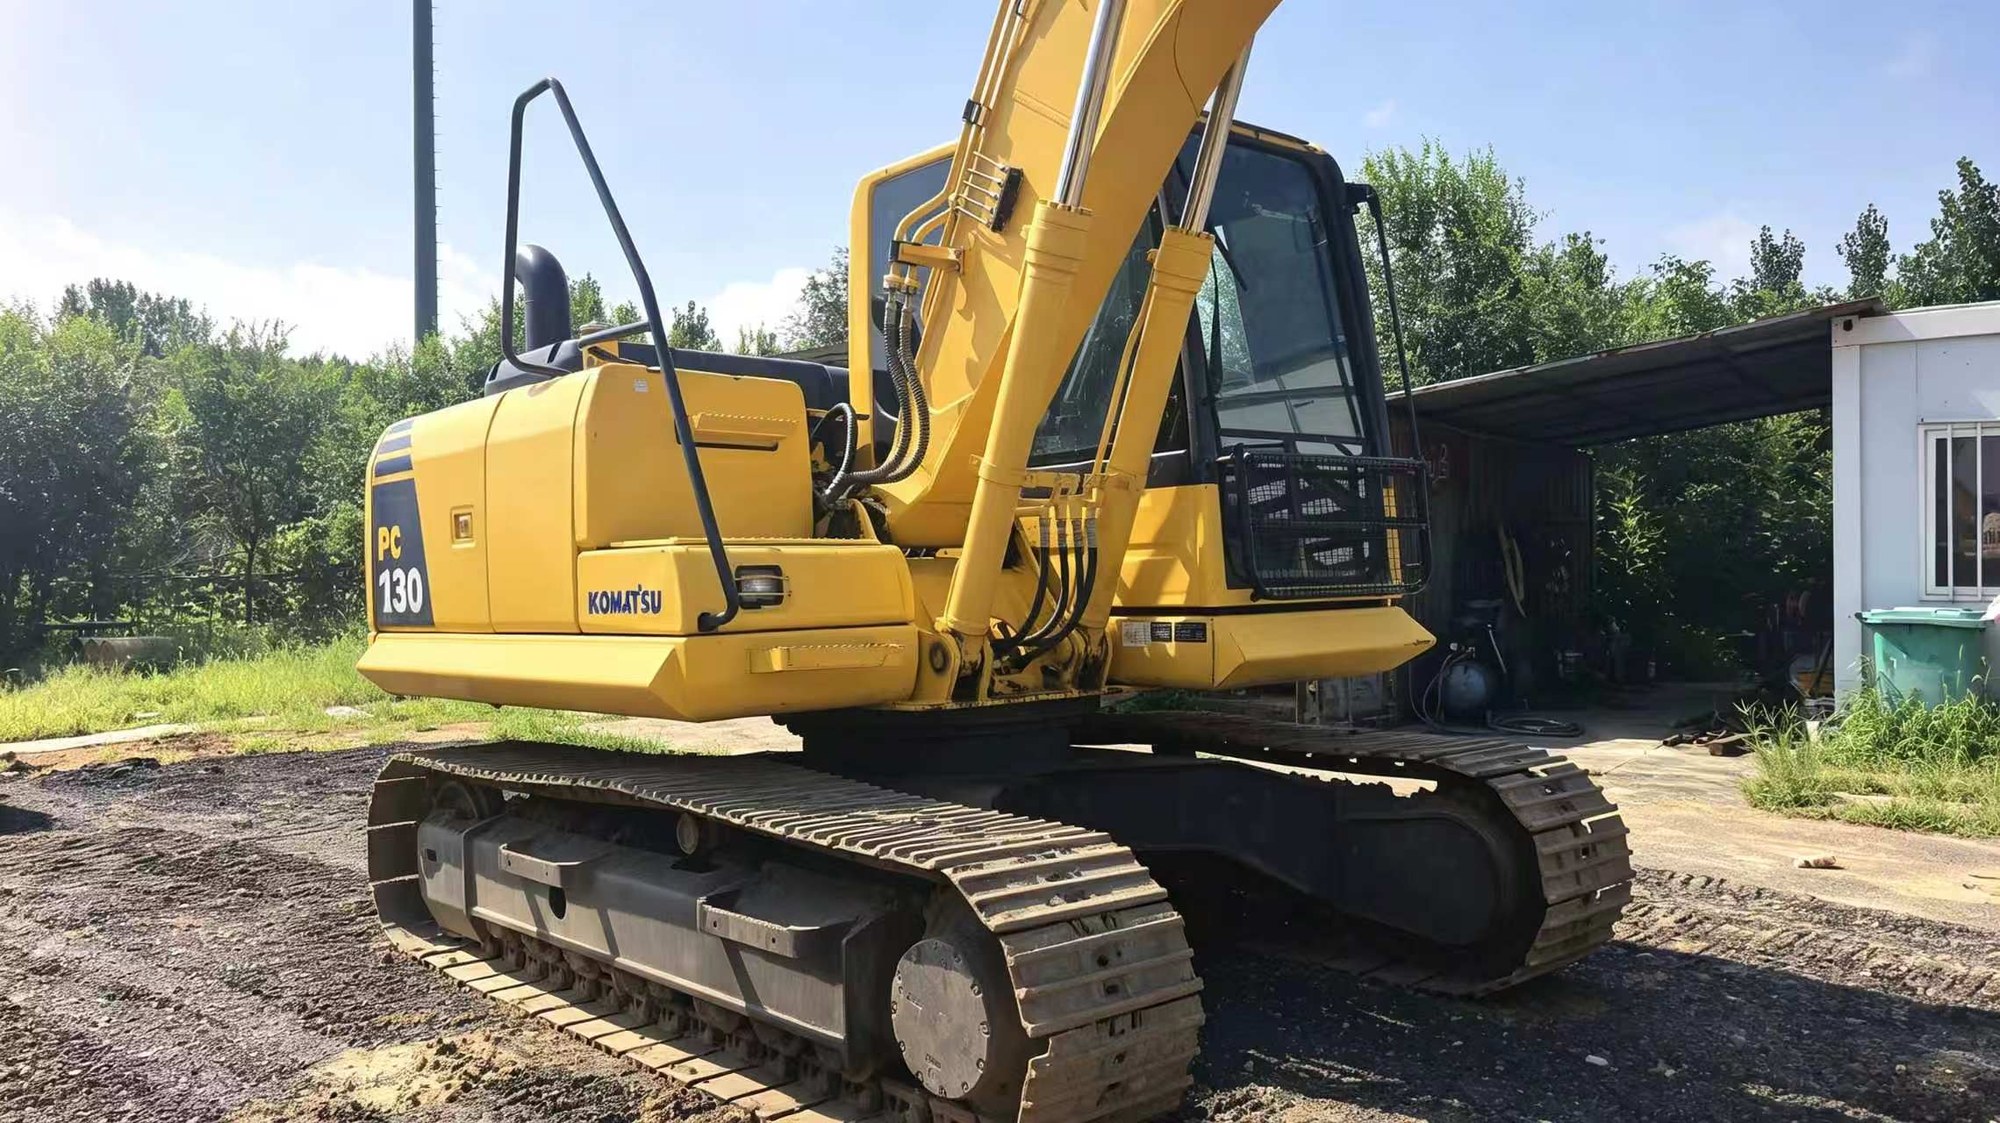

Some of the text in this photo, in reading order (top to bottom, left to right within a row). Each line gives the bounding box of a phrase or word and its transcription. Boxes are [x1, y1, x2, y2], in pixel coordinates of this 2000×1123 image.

[378, 525, 401, 561] PC
[378, 567, 423, 614] 130
[588, 584, 662, 615] KOMATSU
